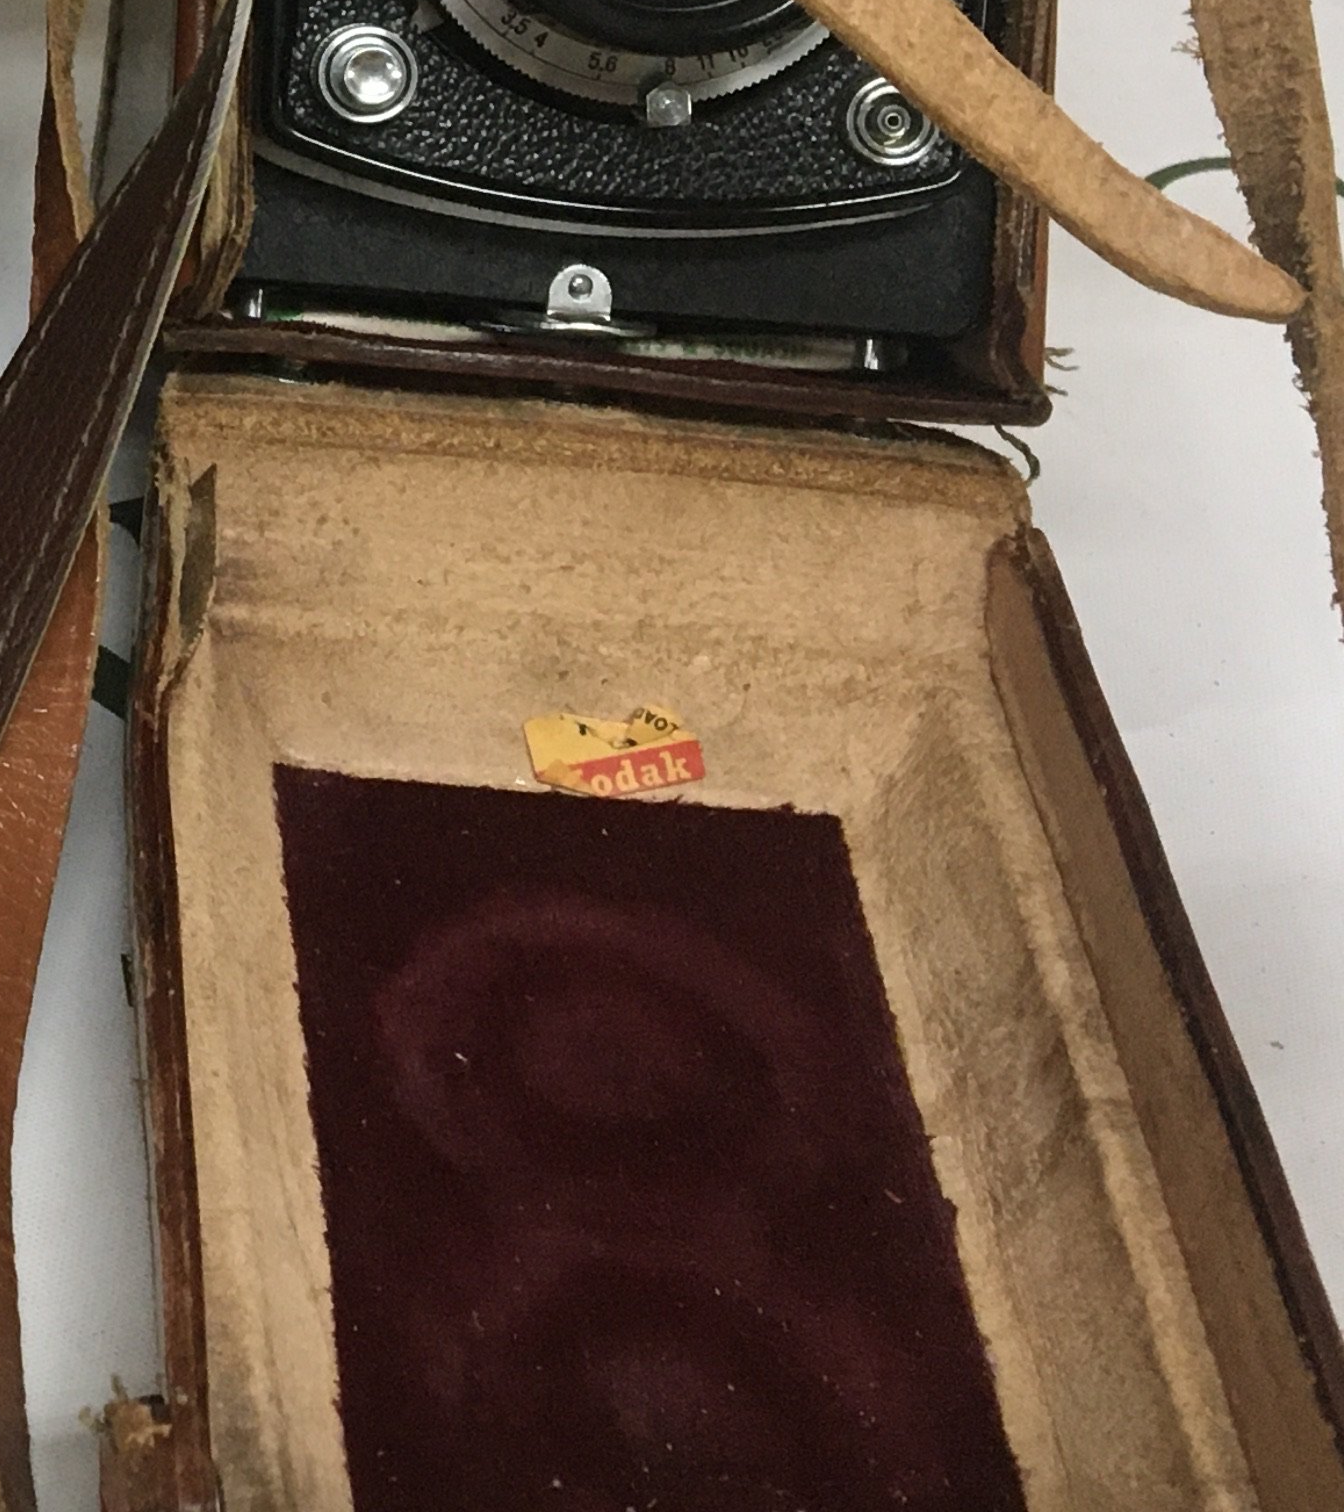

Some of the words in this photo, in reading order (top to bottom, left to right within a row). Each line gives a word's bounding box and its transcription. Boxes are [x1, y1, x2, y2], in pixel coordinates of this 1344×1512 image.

[533, 30, 550, 48] 4
[587, 51, 618, 73] 5.6
[664, 57, 676, 76] 8
